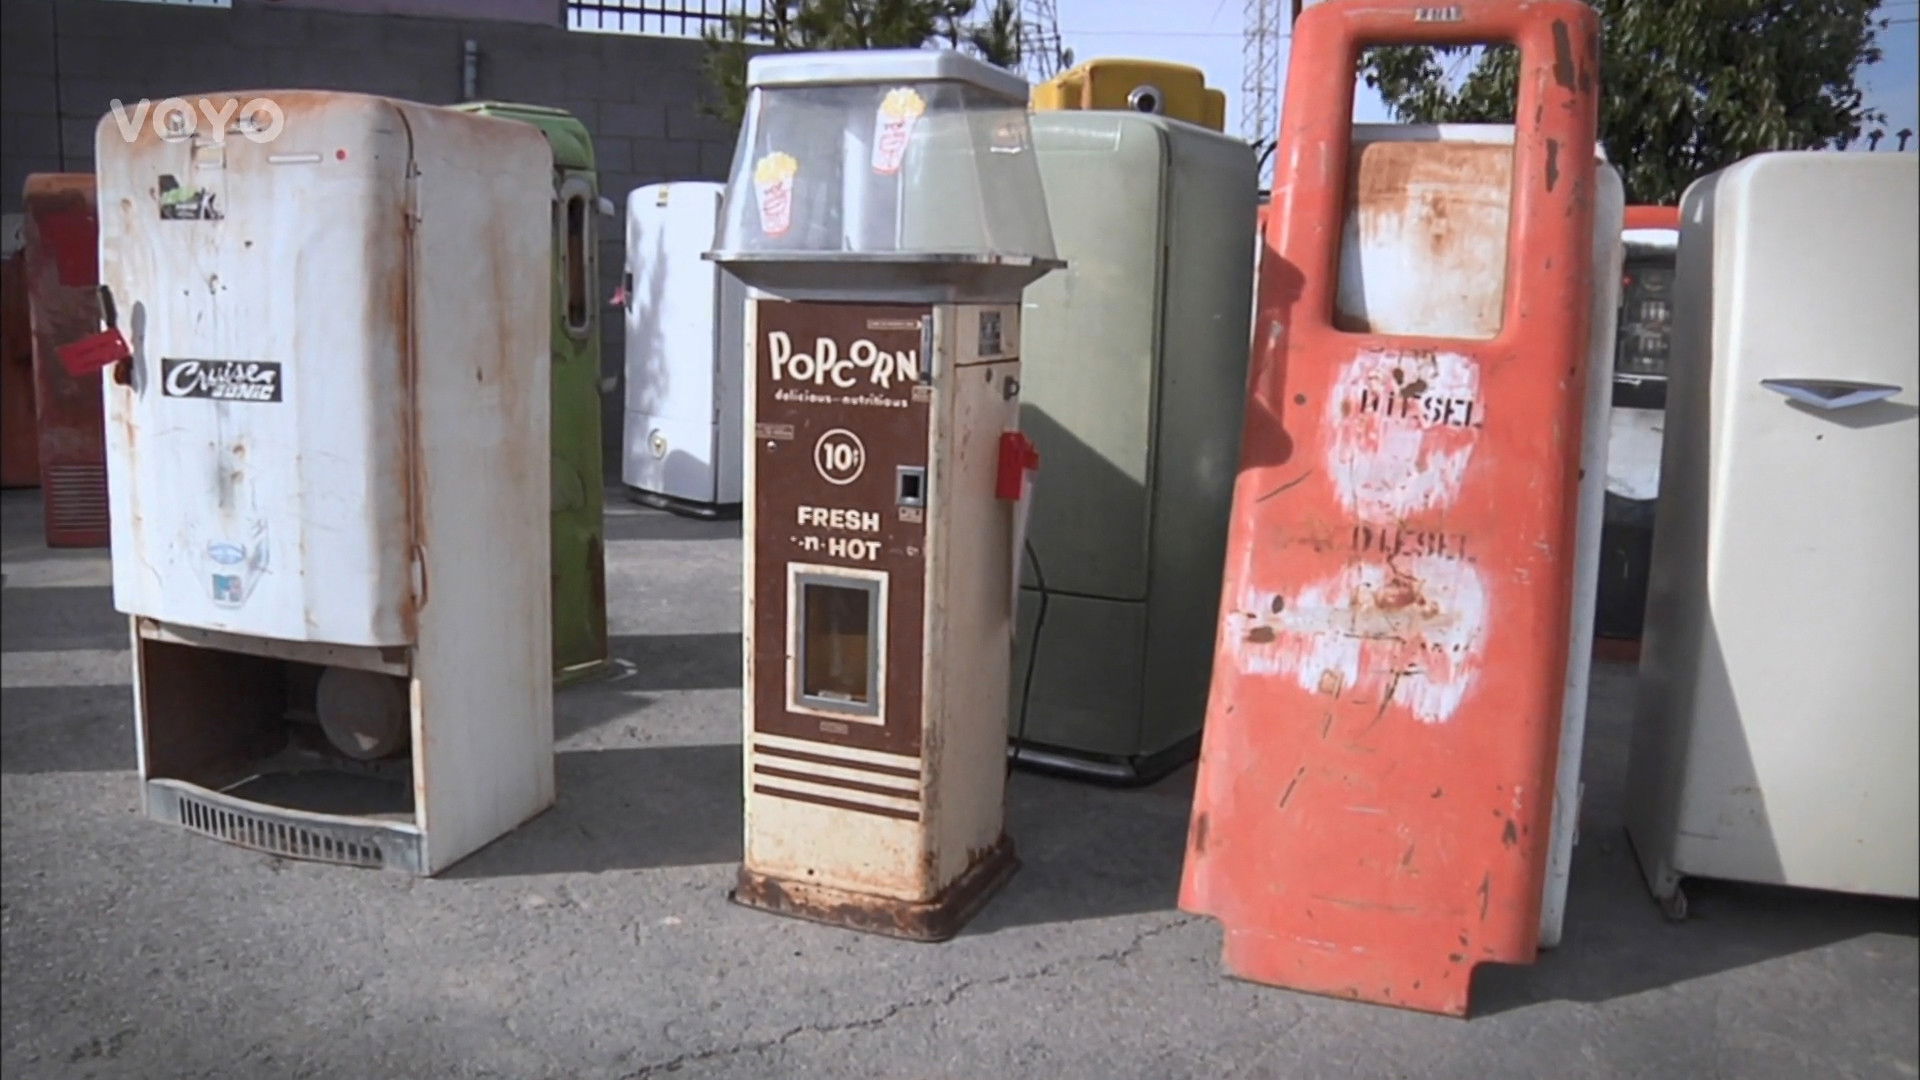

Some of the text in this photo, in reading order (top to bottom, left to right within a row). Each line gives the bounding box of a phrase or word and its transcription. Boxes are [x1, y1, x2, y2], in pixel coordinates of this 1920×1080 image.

[768, 331, 919, 389] POPCORN
[166, 361, 277, 397] Cruise
[797, 506, 880, 532] FRESH
[828, 538, 882, 561] HOT
